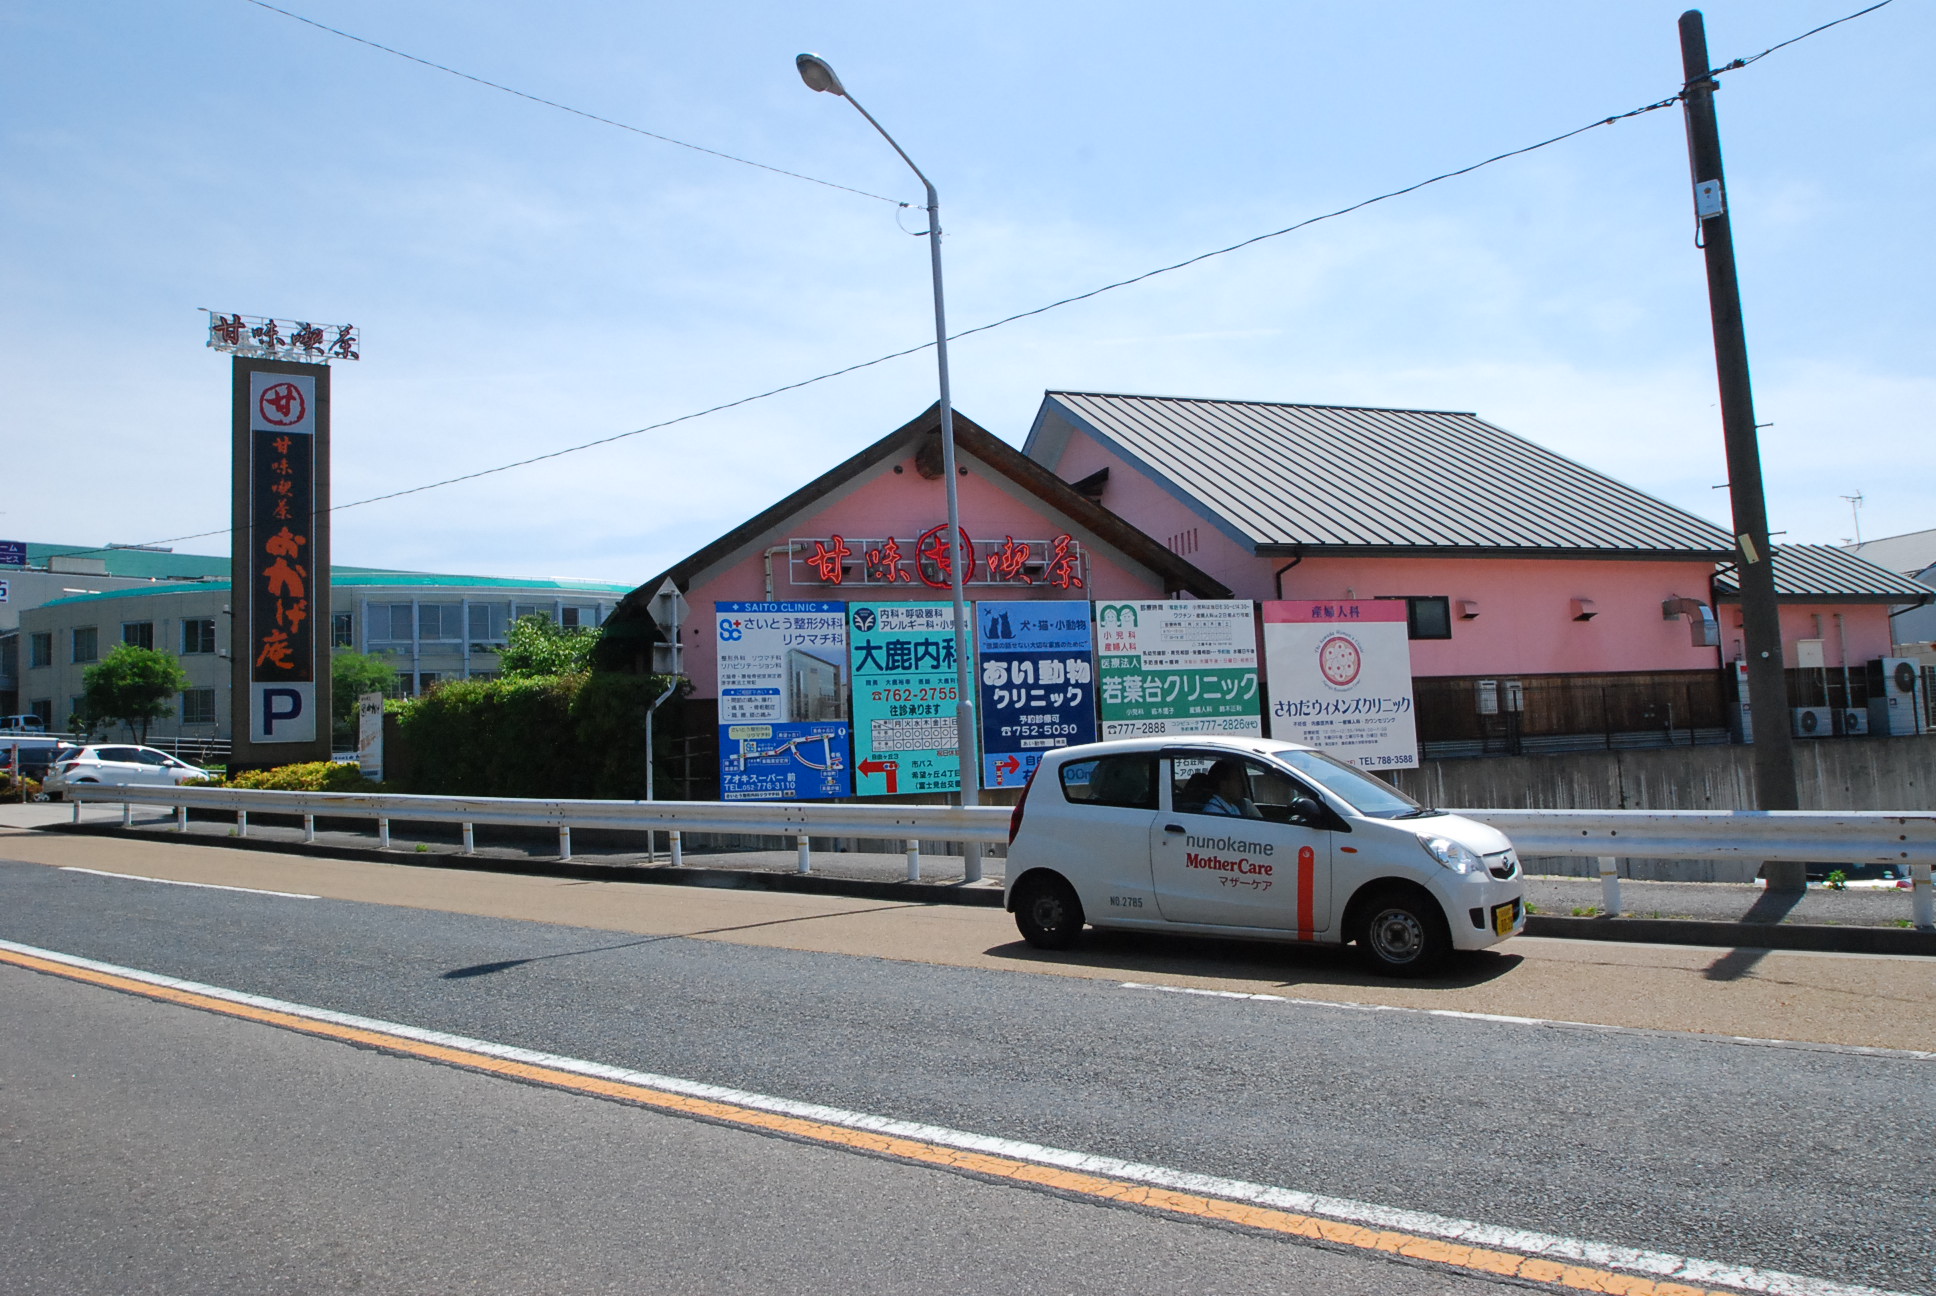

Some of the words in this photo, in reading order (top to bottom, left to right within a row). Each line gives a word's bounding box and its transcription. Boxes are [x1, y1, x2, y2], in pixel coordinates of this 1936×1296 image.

[213, 314, 359, 359] 甘味喫茶
[271, 436, 293, 519] 甘味喫茶
[256, 527, 307, 670] おかげ庵
[745, 603, 777, 612] SAITO
[781, 603, 817, 611] CLINIC
[880, 609, 943, 619] 内科・呼吸器科
[1311, 605, 1361, 618] 産婦人科
[744, 617, 843, 630] さいとう整形外科
[1020, 619, 1087, 631] 犬・猫・小動物
[783, 634, 843, 645] リウマチ科
[1103, 631, 1136, 640] 小児科
[1104, 642, 1137, 651] 産婦人科
[1101, 657, 1140, 668] 医療法人
[983, 659, 1091, 686] あい動物
[884, 687, 957, 702] 762-2755
[1102, 673, 1258, 704] 若葉台クリニック
[994, 687, 1082, 709] クリニック
[263, 688, 302, 735] P
[890, 703, 941, 716] 往診承ります
[1274, 697, 1411, 717] さわだウィメンズクリニック
[1019, 714, 1060, 724] 予約診療可
[1117, 722, 1166, 735] 777-2888
[912, 760, 933, 768] 市バス
[1359, 757, 1375, 766] TEL
[1377, 755, 1413, 765] 788-3588
[723, 773, 784, 784] アオキスーパー
[787, 772, 796, 782] 前
[1186, 836, 1274, 857] nunokame
[1186, 853, 1273, 876] MotherCare
[1218, 876, 1273, 891] マザーケア
